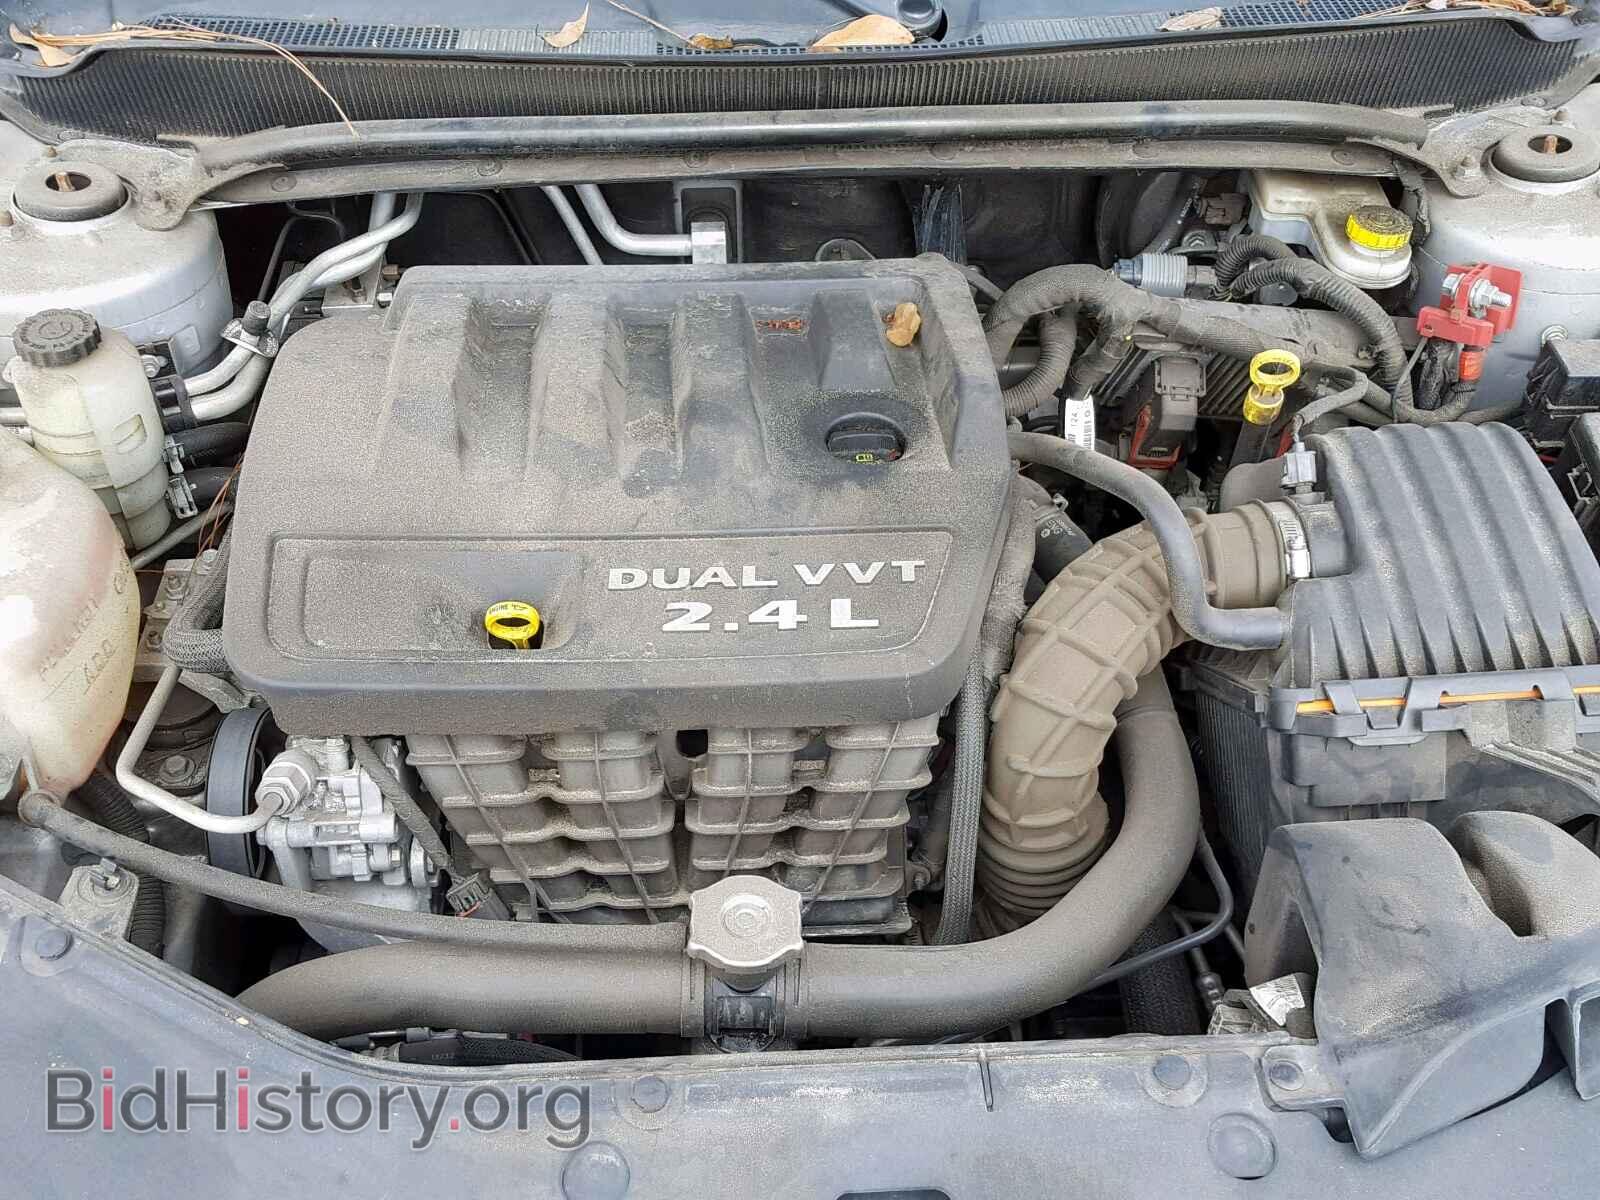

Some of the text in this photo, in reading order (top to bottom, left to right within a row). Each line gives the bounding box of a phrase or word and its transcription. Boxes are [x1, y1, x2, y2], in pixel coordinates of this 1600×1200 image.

[608, 559, 926, 590] DUAL VVT
[662, 598, 880, 632] 2.4 L
